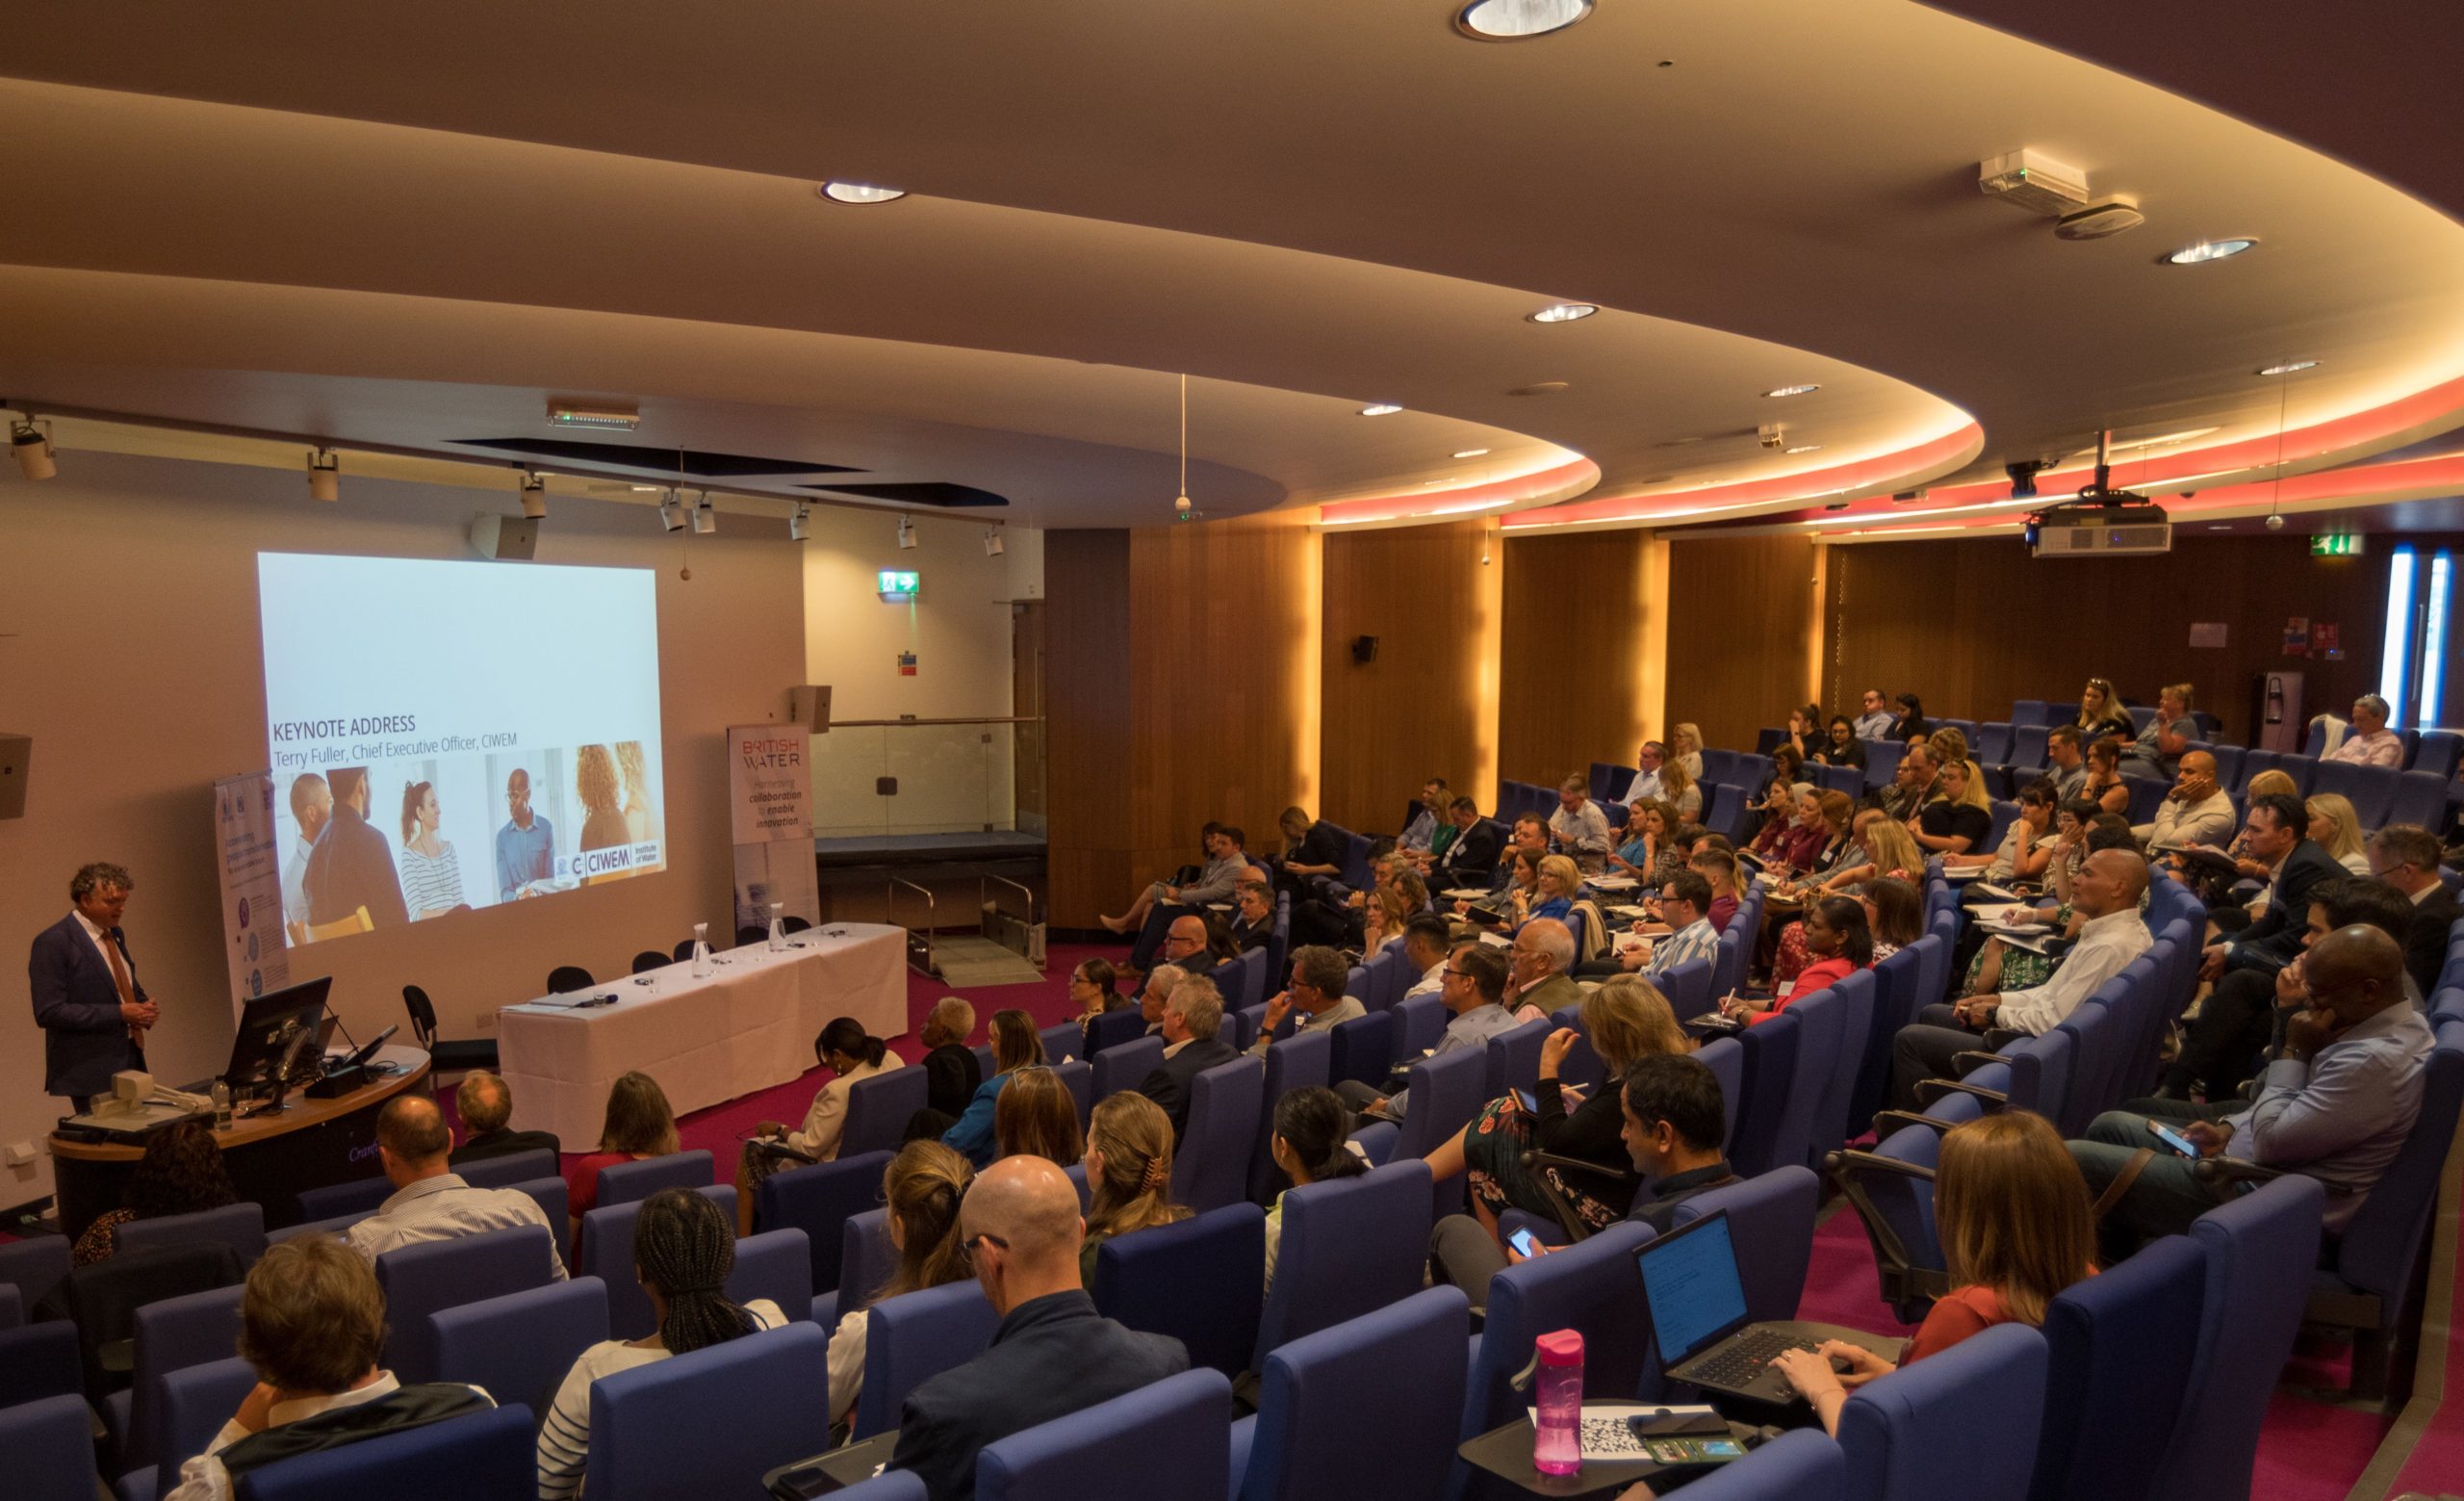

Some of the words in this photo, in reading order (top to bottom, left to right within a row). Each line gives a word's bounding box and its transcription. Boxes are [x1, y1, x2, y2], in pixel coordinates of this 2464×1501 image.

[273, 719, 346, 741] KEYNOTE
[350, 715, 416, 736] ADDRESS
[274, 750, 307, 769] Terry
[311, 746, 349, 763] Fuller,
[352, 741, 383, 761] Chief
[386, 738, 439, 757] Executive
[442, 735, 479, 752] Officer,
[482, 733, 517, 748] CIWEM
[743, 738, 798, 754] BRITISH
[744, 753, 800, 770] WATER
[750, 791, 802, 803] collaboration
[767, 804, 795, 815] enable
[757, 816, 798, 828] innovation
[588, 849, 629, 871] CIWEM
